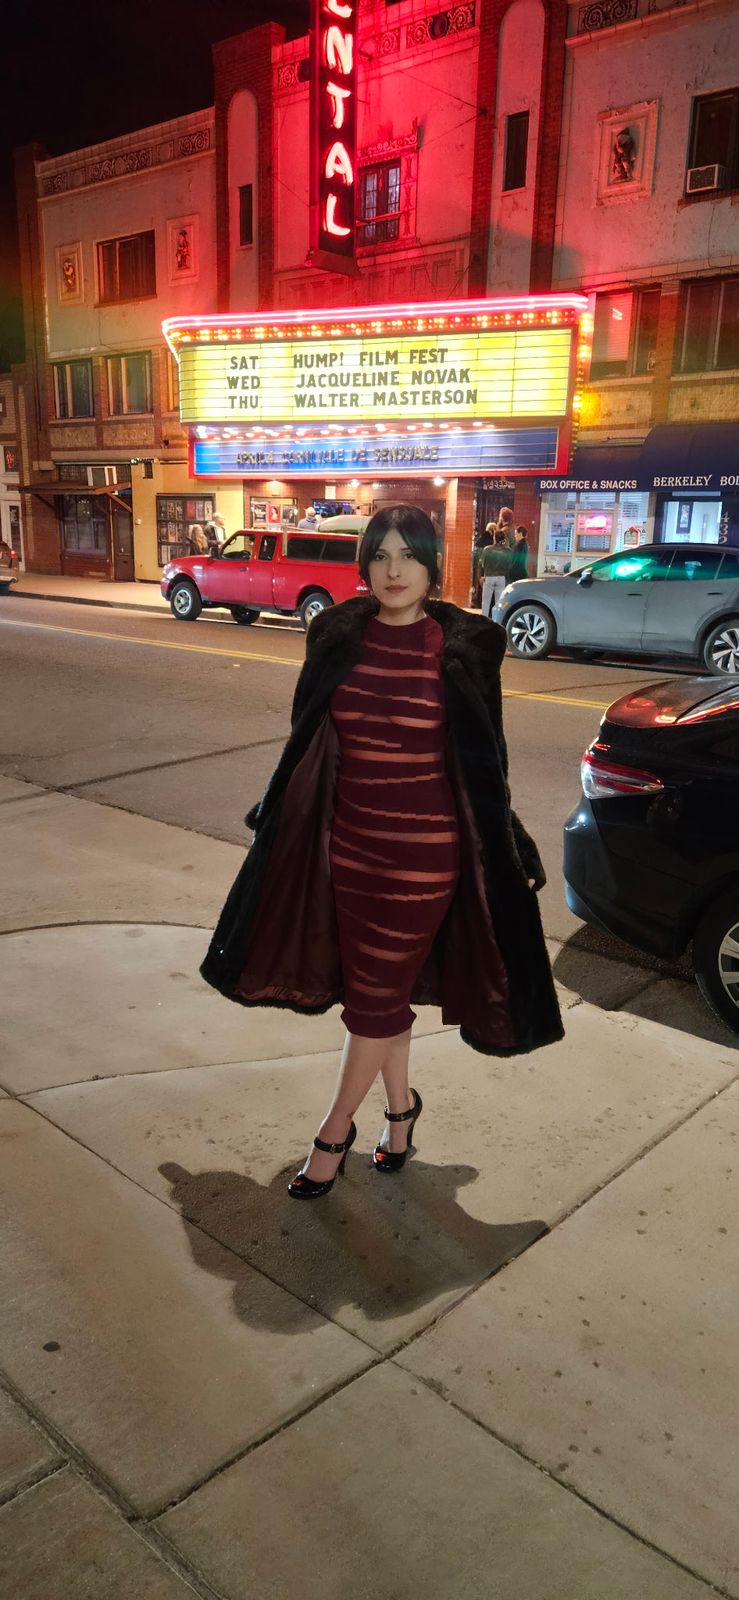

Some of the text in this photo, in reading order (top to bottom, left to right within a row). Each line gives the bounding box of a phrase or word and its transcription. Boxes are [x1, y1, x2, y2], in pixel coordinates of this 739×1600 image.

[230, 348, 448, 370] SAT HUMP! FILM FEST
[227, 368, 471, 390] WED JACQUELINE NOVAK
[228, 389, 478, 409] THU WALTER MASTERSON
[540, 479, 637, 489] BOX OFFICE & SNACKS
[653, 474, 712, 487] BERKELEY
